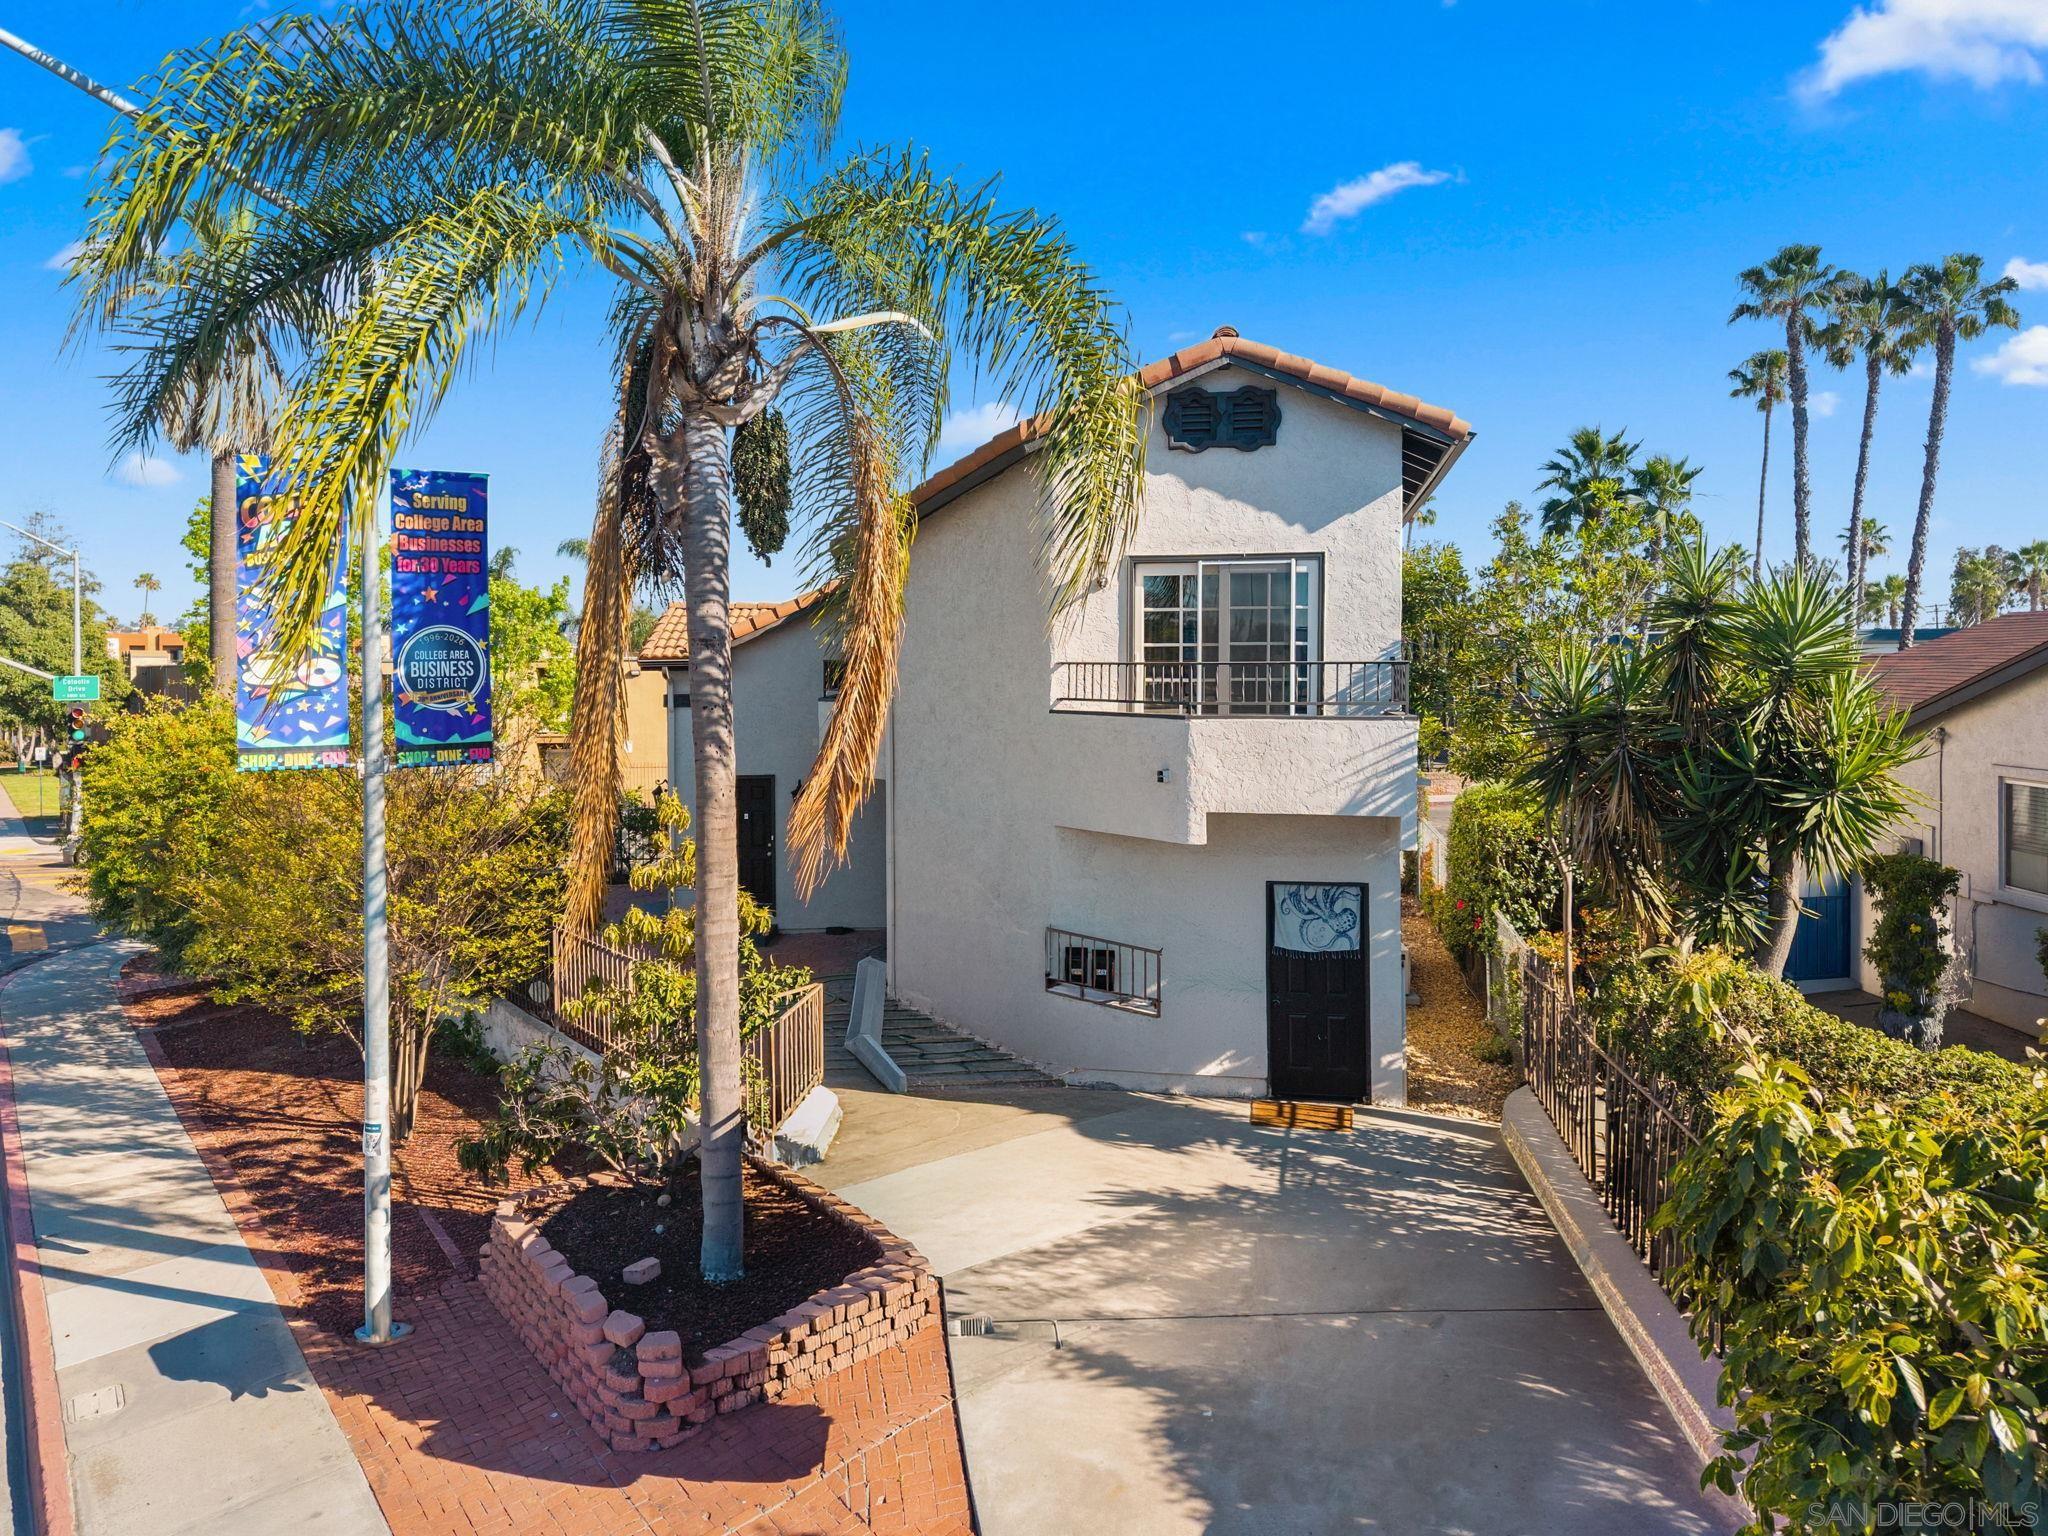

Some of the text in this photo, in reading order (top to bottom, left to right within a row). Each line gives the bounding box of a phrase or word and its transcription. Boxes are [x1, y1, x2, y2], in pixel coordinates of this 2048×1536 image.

[413, 492, 467, 512] Serving
[395, 513, 484, 532] College Area
[399, 534, 481, 553] Businesses
[396, 556, 480, 573] for 30 Years
[415, 650, 470, 660] COLLEGE AREA
[410, 660, 474, 677] BUSINESS
[417, 677, 468, 689] DISTRICT
[239, 754, 276, 768] SHOP
[284, 752, 314, 766] DINE
[398, 751, 429, 764] SHOP
[436, 749, 462, 762] DINE
